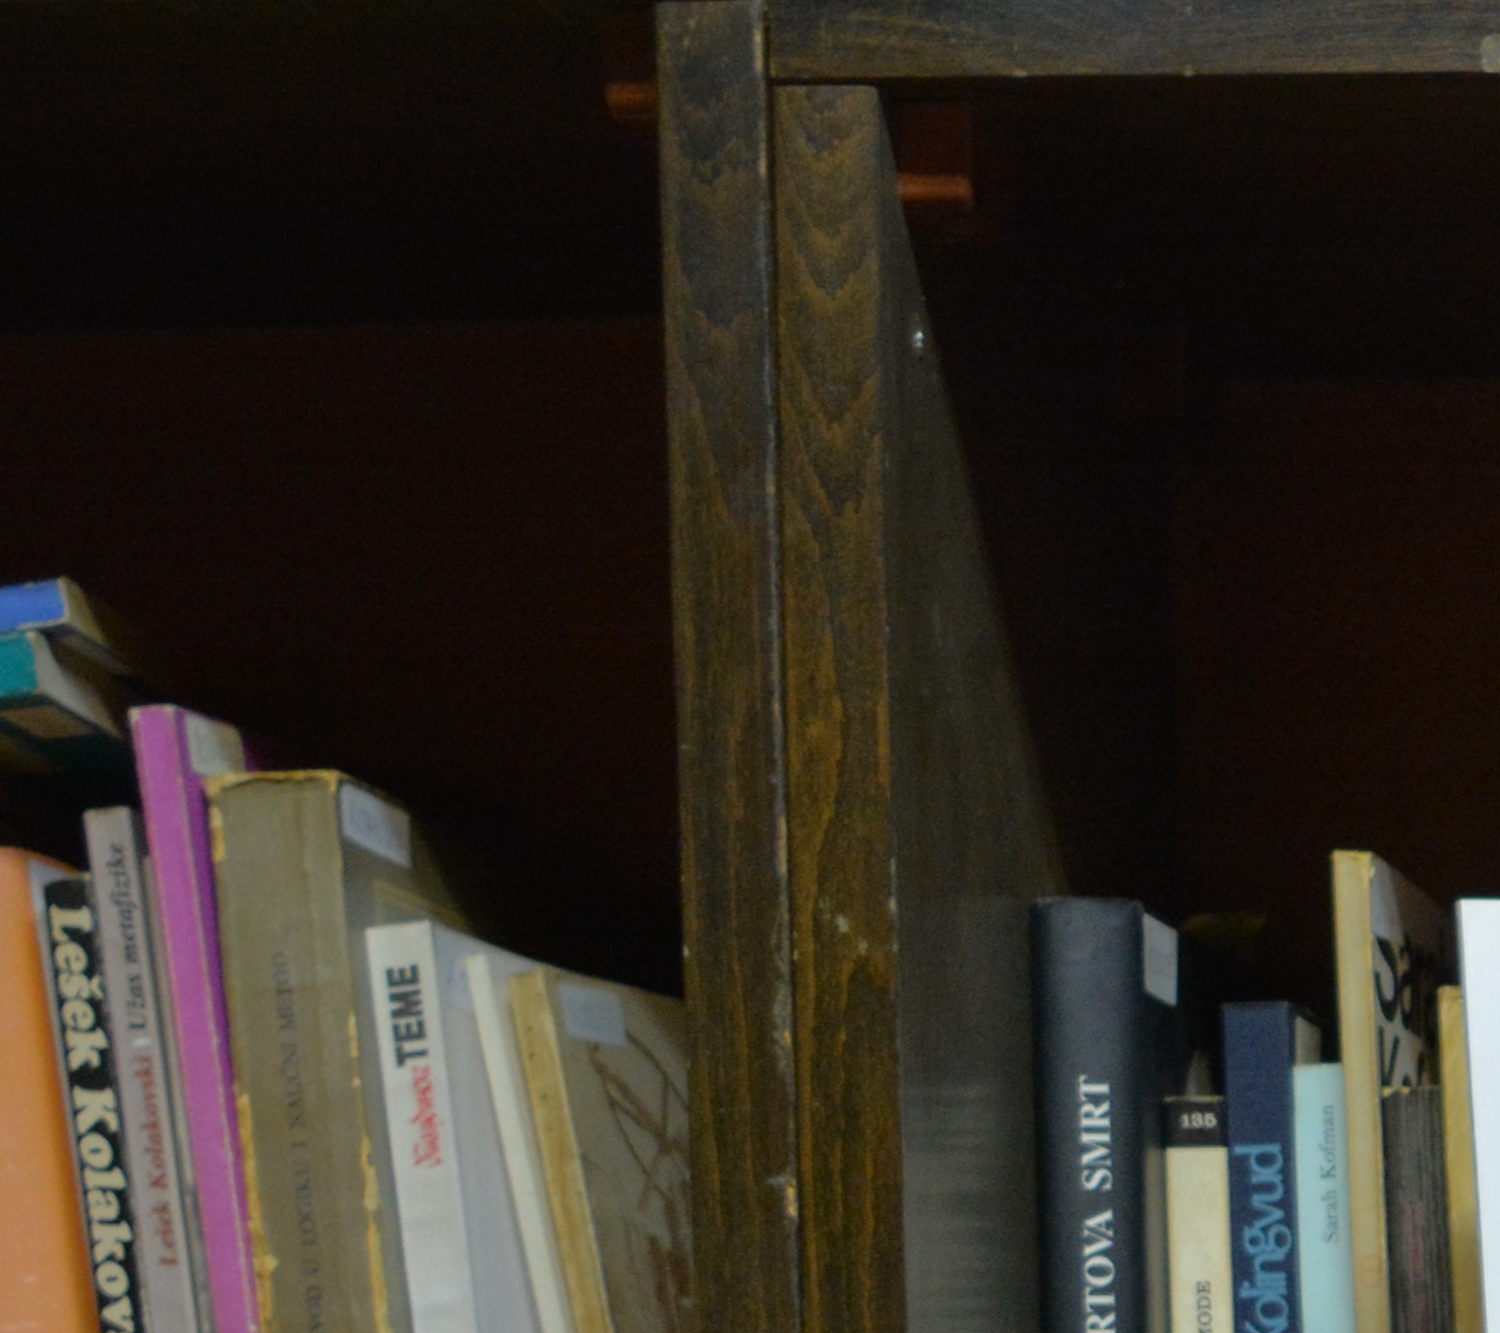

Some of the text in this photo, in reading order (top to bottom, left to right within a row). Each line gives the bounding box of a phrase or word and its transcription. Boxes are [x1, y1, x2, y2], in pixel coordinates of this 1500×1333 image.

[50, 902, 107, 1069] Lešek
[385, 964, 429, 1068] TEME
[1078, 1075, 1115, 1192] SMRT
